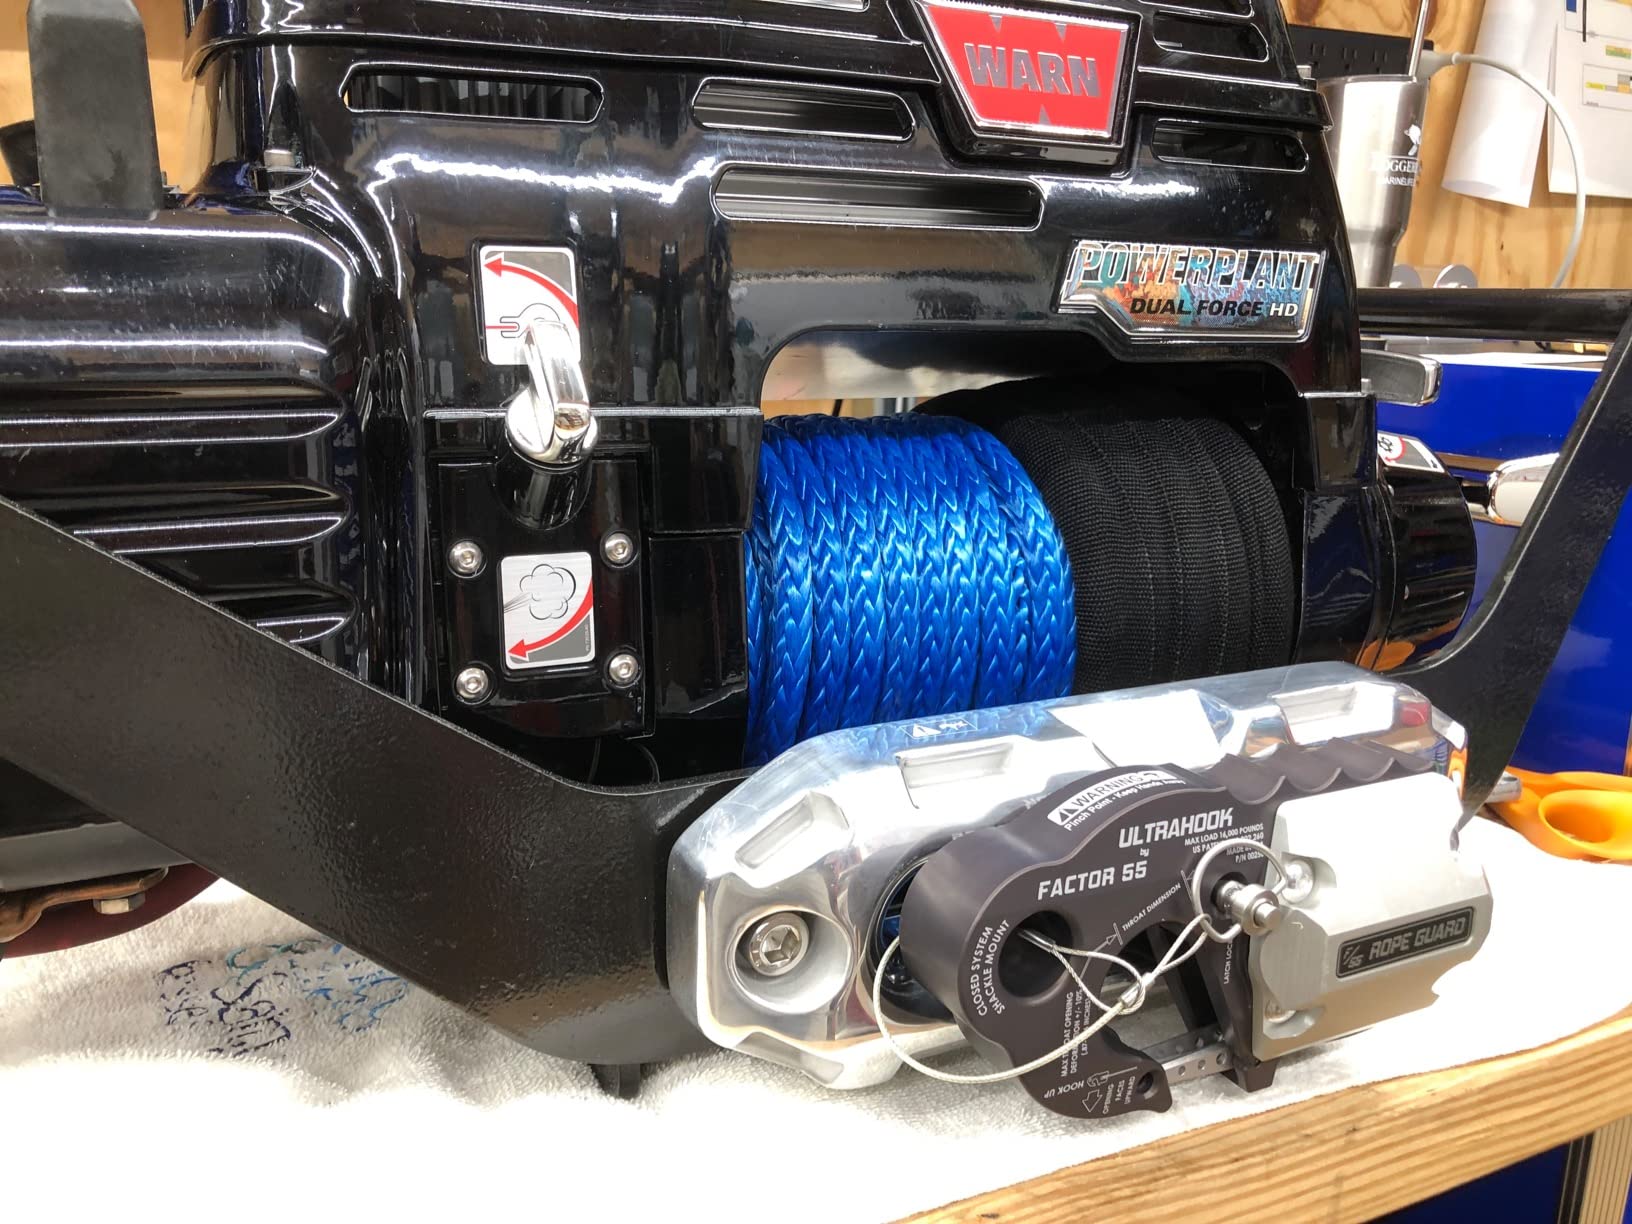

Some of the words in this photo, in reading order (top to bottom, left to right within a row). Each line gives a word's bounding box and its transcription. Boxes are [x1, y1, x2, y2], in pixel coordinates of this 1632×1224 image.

[964, 43, 1101, 97] WARN
[1075, 240, 1319, 290] POWERPLANT
[1130, 298, 1191, 315] DUAL
[1197, 300, 1263, 317] FORCE
[1269, 303, 1298, 316] HD
[1064, 811, 1090, 831] Pinch
[1088, 796, 1113, 814] Point
[1115, 785, 1138, 799] Keep
[1071, 773, 1144, 807] WARNING
[1119, 807, 1233, 848] ULTRAHOOK
[1185, 838, 1200, 846] MAX
[1201, 832, 1218, 843] LOAD
[1239, 823, 1264, 834] POUNDS
[1139, 848, 1150, 857] by
[1193, 845, 1201, 854] US
[1038, 867, 1116, 900] FACTOR
[1122, 861, 1148, 882] 55
[1122, 909, 1146, 931] THROAT
[1146, 882, 1182, 913] DIMENSION
[971, 926, 993, 971] SYSTEM
[985, 919, 1010, 964] MOUNT
[1369, 932, 1413, 960] ROPE
[1414, 917, 1466, 946] GUARD
[1223, 960, 1232, 984] LATCH
[970, 974, 988, 1016] CLOSED
[983, 967, 1006, 1014] SHACKLE
[1064, 991, 1074, 1027] OPENING
[1062, 1028, 1072, 1057] TOAT
[1061, 1059, 1069, 1077] MAX
[1044, 1089, 1056, 1098] UP
[1057, 1080, 1085, 1094] HOOK
[1103, 1083, 1114, 1114] OPENING
